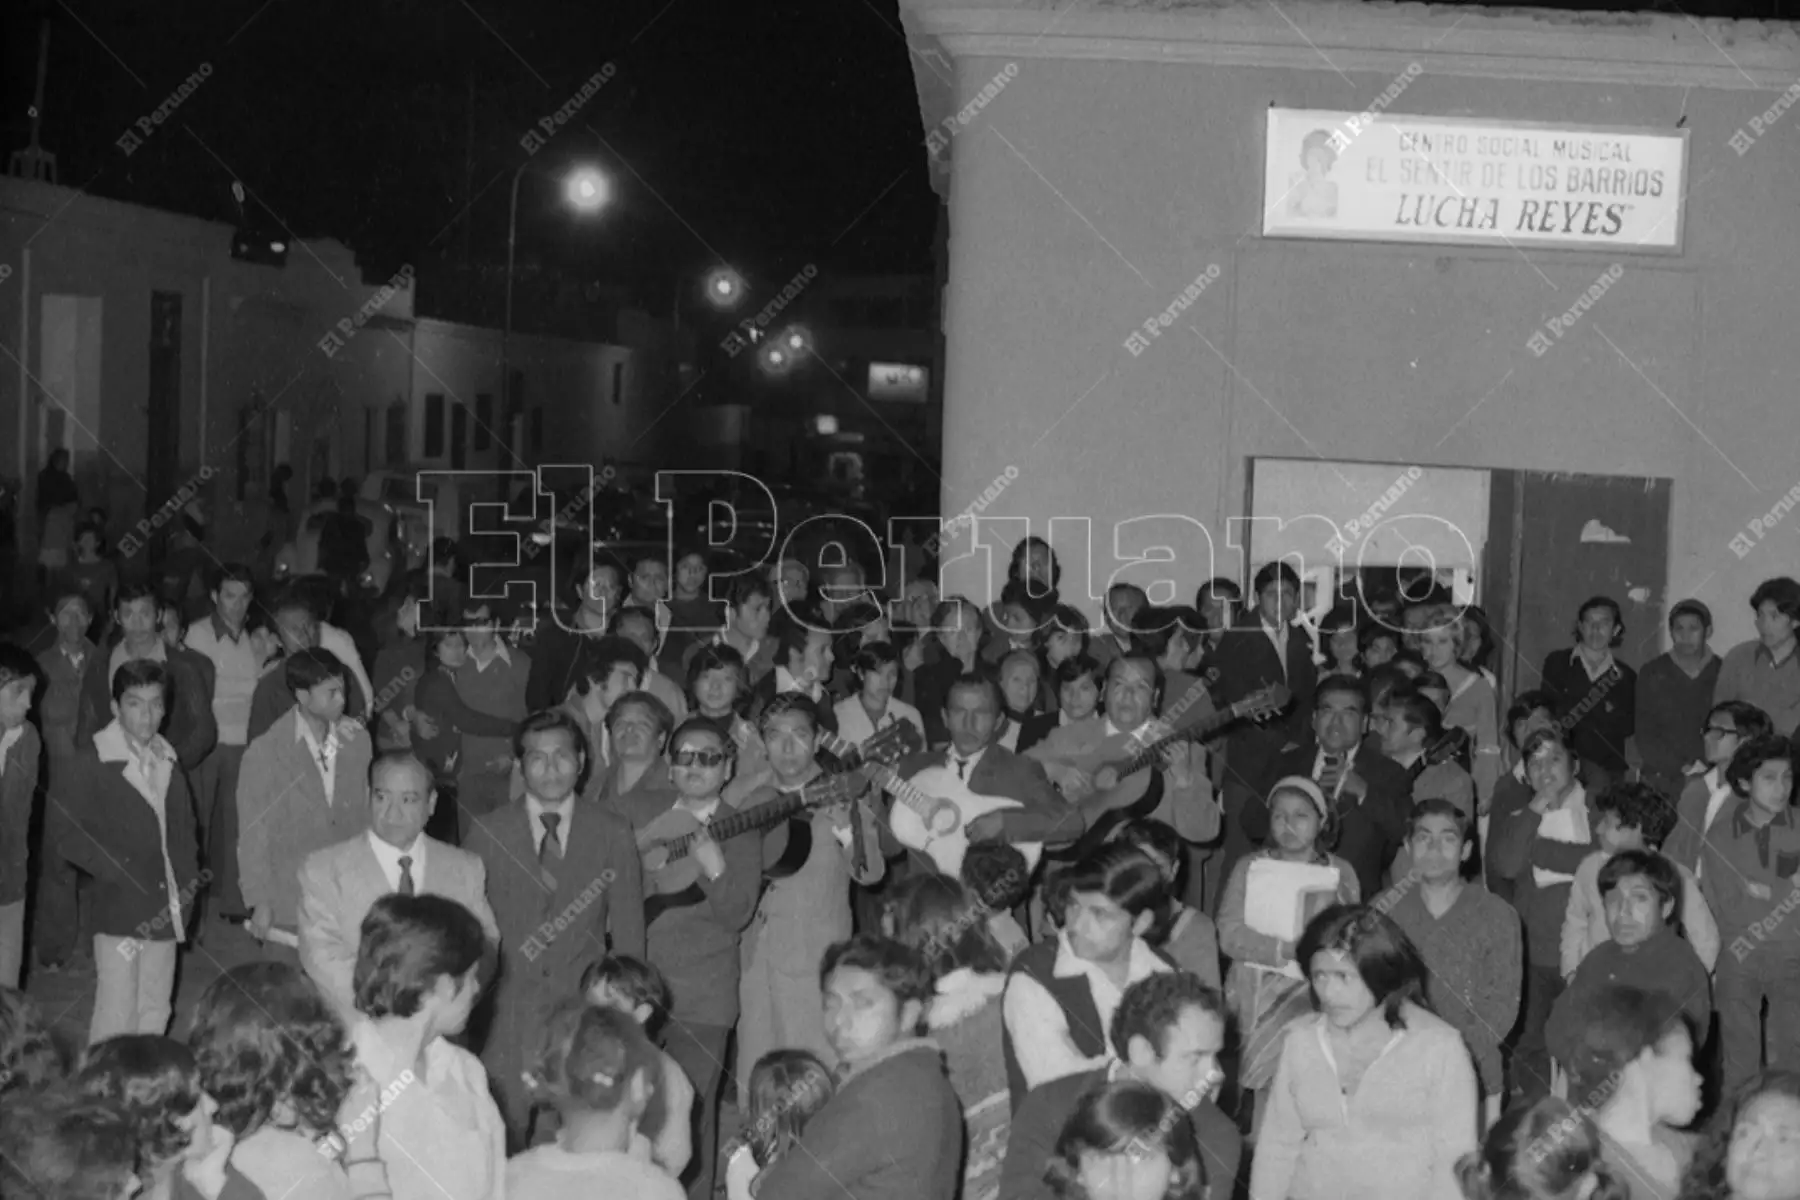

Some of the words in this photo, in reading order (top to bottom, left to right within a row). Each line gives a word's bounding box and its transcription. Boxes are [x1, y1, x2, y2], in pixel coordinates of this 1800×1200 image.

[1400, 131, 1468, 154] CENTRO
[1477, 135, 1540, 158] SOCIAL
[1553, 139, 1632, 162] MUSICAL
[1366, 157, 1388, 184] EL
[1482, 161, 1507, 190] DE
[1517, 163, 1557, 193] LOS
[1566, 166, 1664, 197] BARRIOS
[1396, 193, 1499, 230] LUCHA
